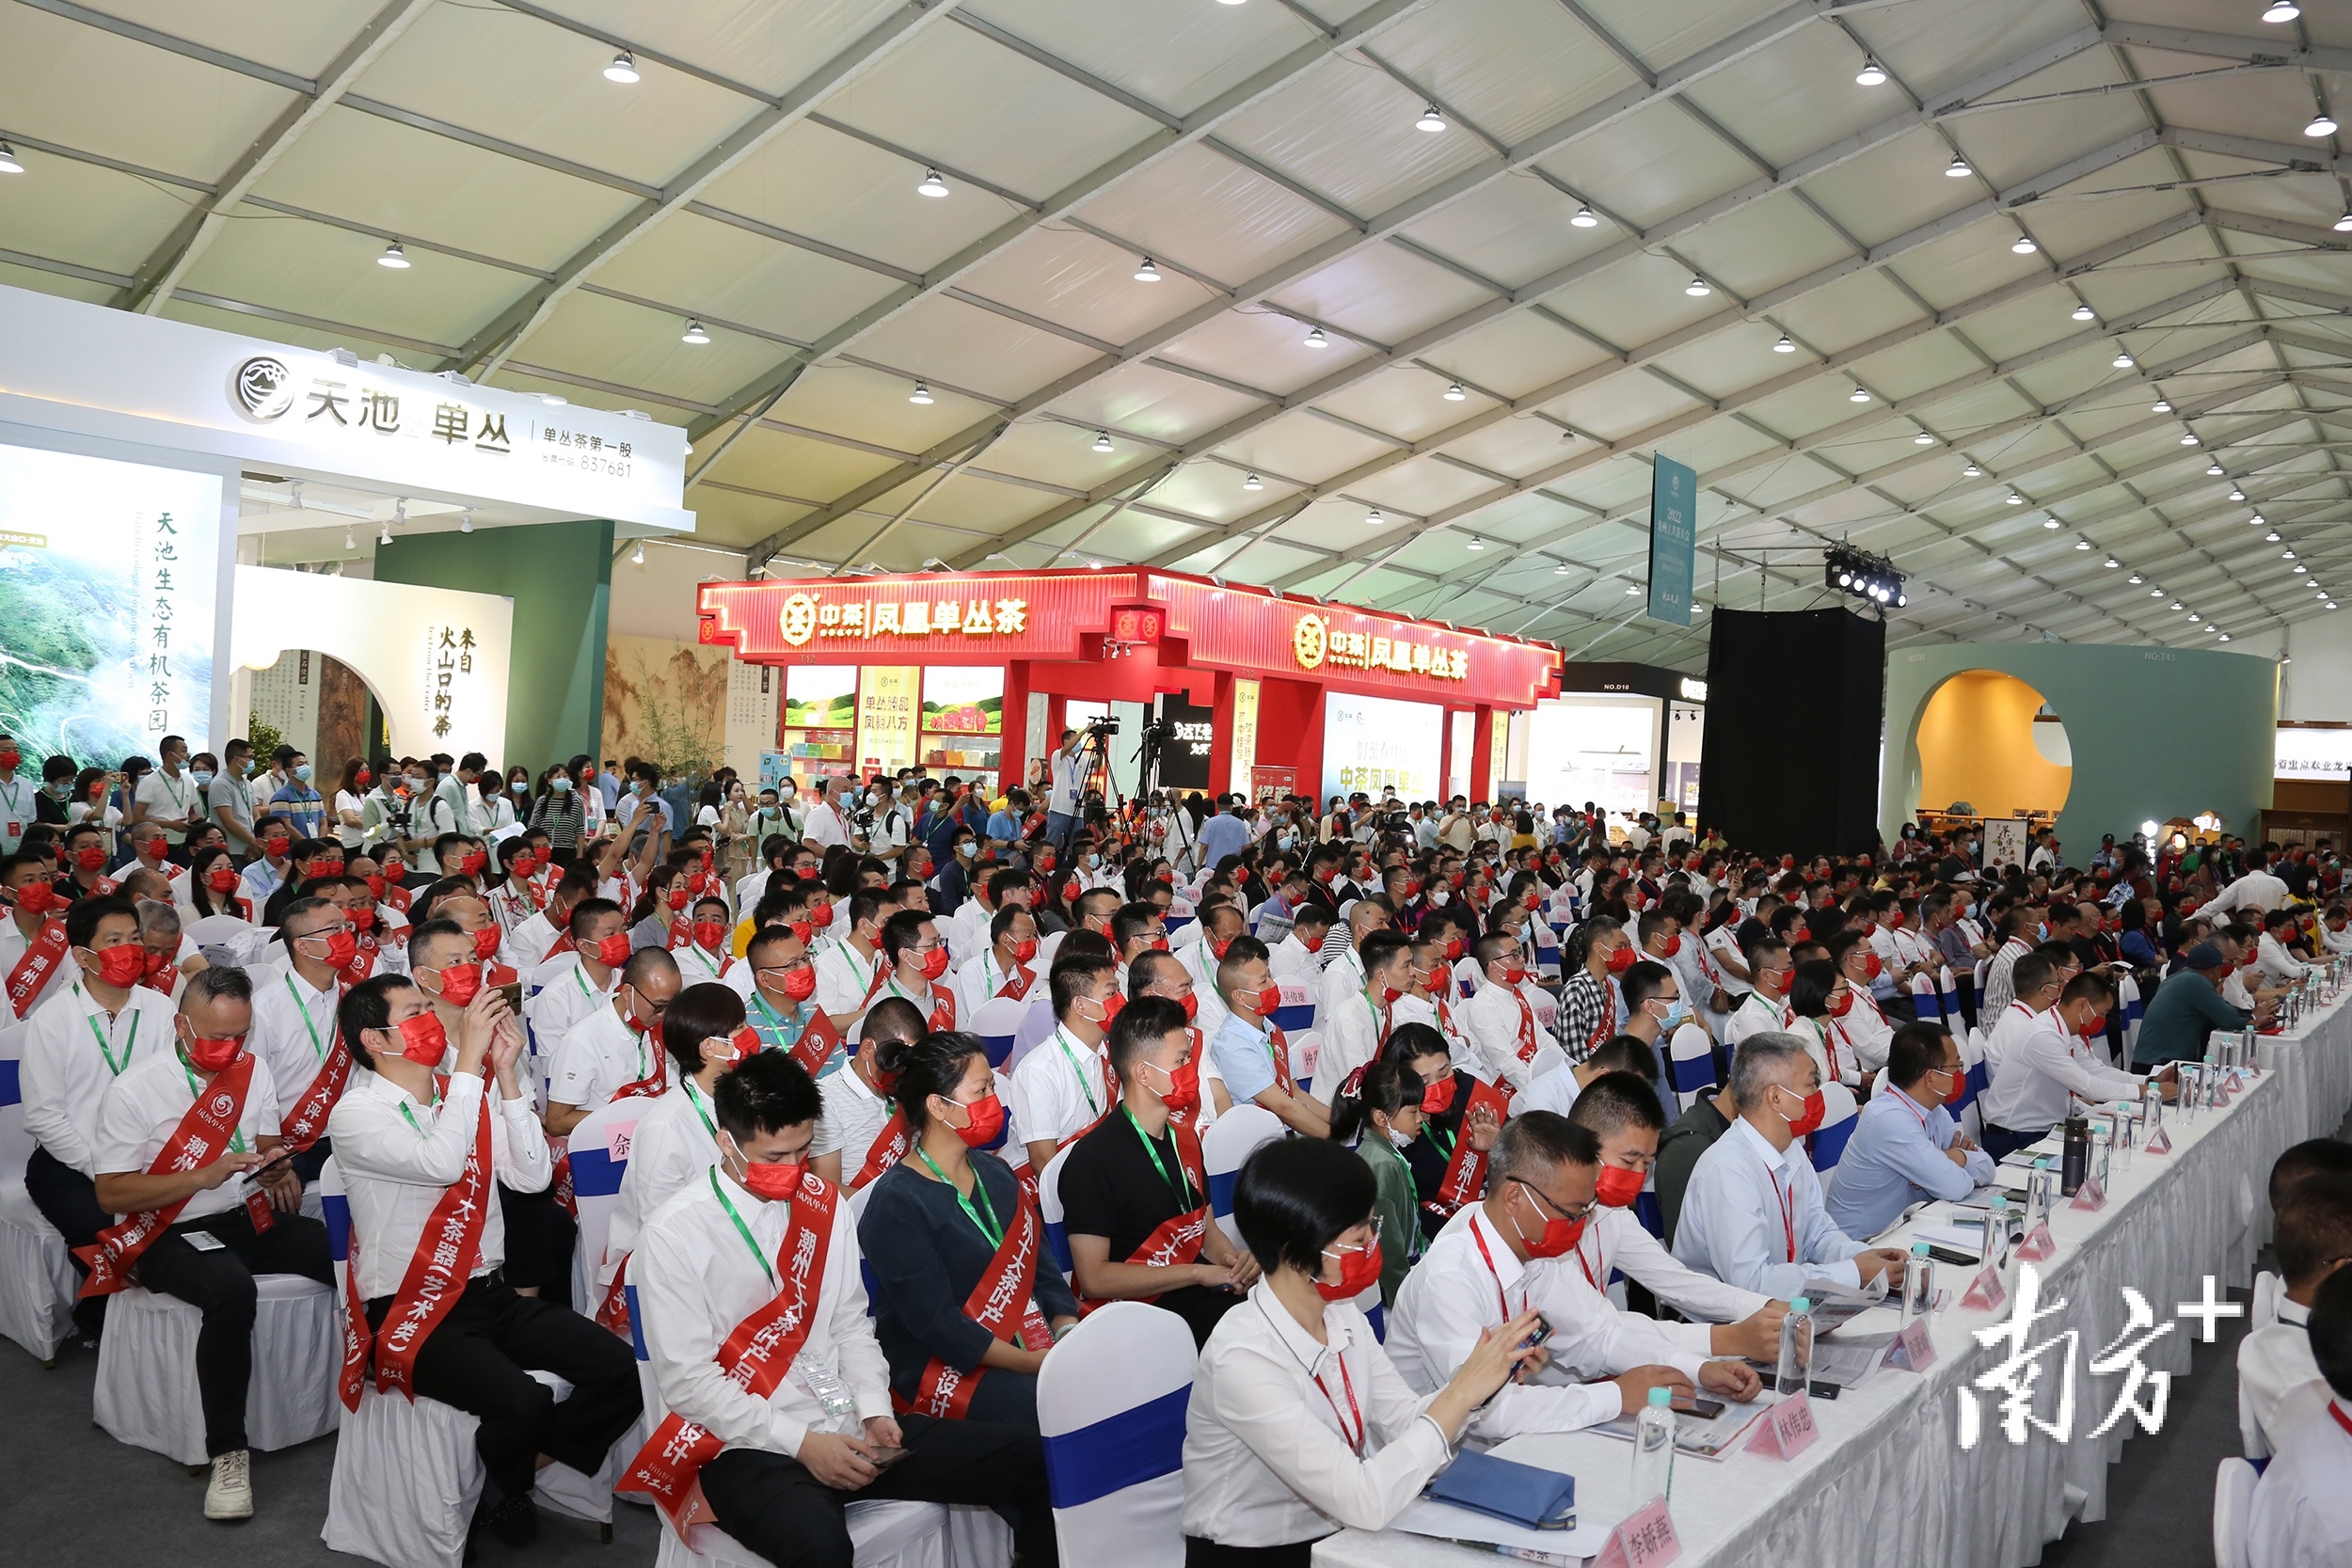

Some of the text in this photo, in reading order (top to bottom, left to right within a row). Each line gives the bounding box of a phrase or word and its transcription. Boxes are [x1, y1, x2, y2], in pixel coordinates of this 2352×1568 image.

[306, 378, 399, 434] 天池
[432, 404, 511, 453] 单丛
[543, 427, 632, 458] 单丛茶第一股
[580, 455, 630, 478] 837681
[1667, 508, 1682, 524] 2022
[148, 512, 178, 733] 天池生态有机茶园
[819, 598, 1027, 636] 中茶 凤凰单丛茶
[800, 654, 817, 665] T12
[1329, 630, 1469, 680] 中茶 凤凰单丛茶
[2144, 652, 2175, 662] NO:T43
[433, 626, 456, 739] 火山口的茶
[1282, 991, 1307, 1003] 吴俊雄
